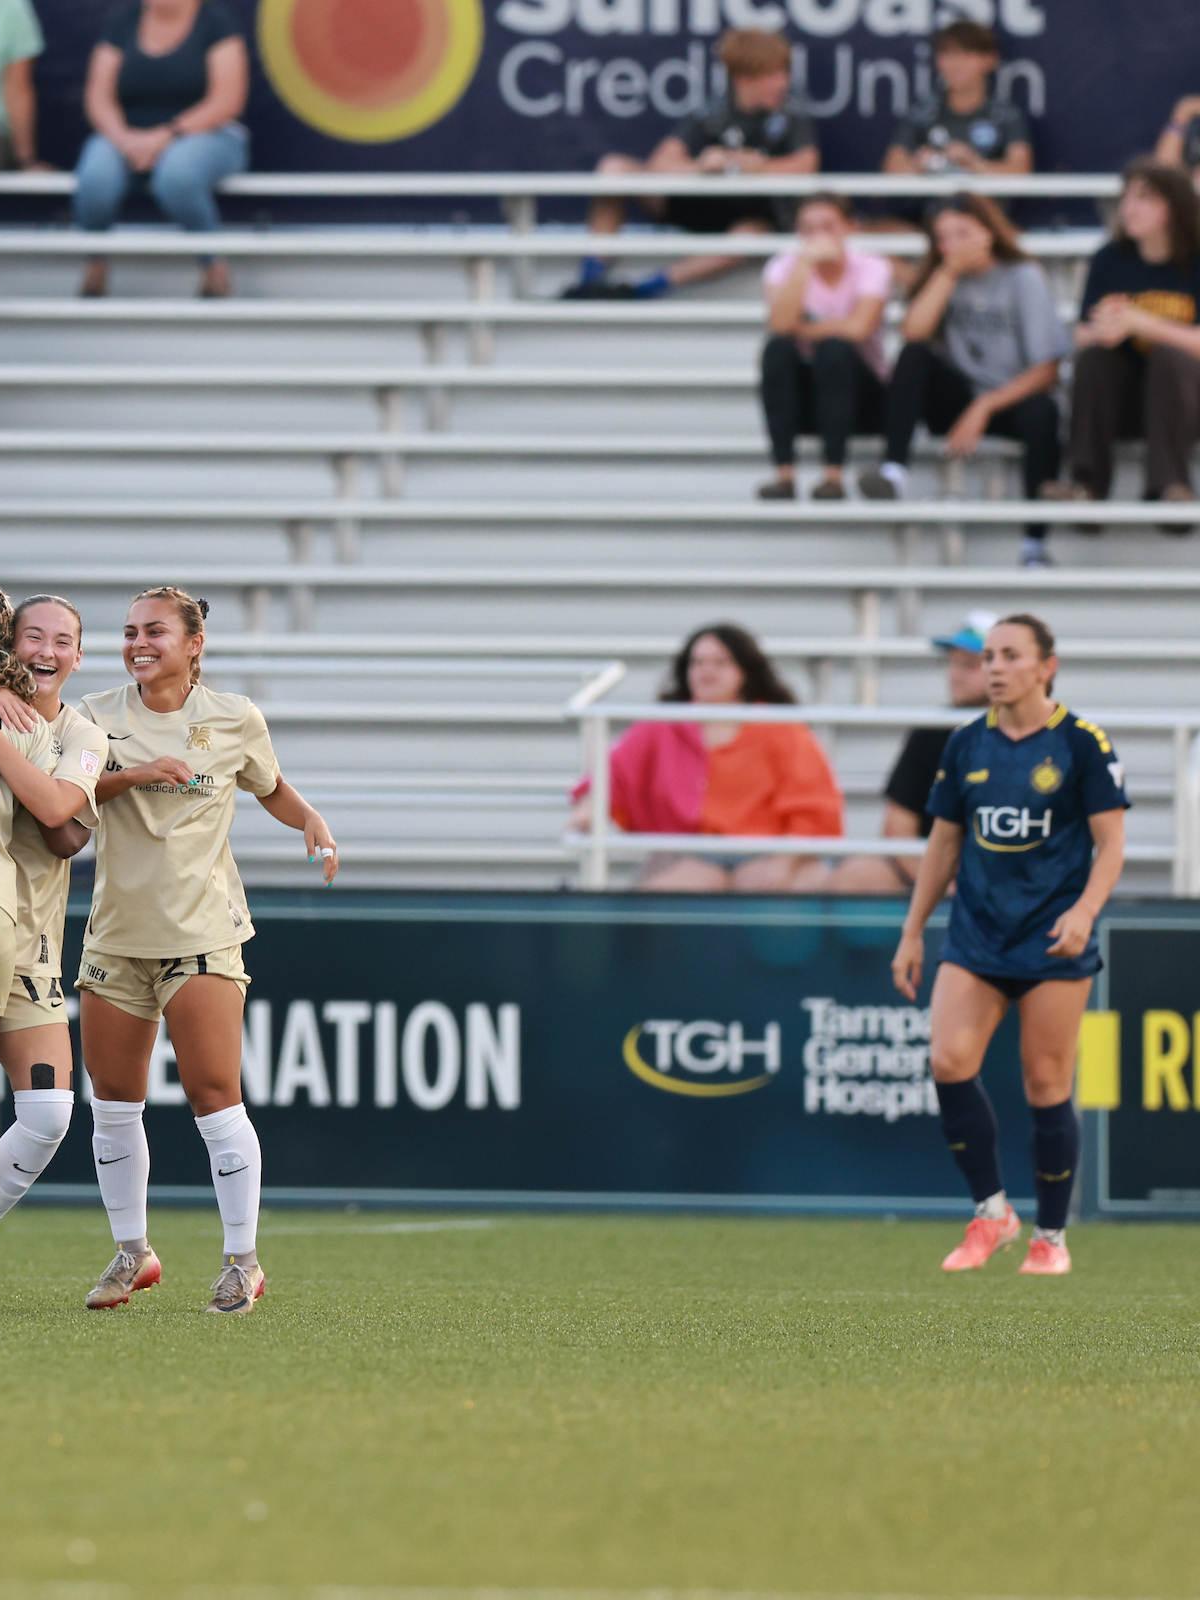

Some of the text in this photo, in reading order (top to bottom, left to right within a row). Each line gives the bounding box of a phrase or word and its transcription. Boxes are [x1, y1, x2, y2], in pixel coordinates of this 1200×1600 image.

[499, 40, 1046, 118] Credi Unin
[180, 785, 214, 797] Center
[976, 806, 1052, 838] TGH
[241, 1000, 521, 1111] NATION
[643, 1019, 781, 1074] TGH
[803, 1036, 931, 1078] Gener
[1143, 1009, 1200, 1112] R
[804, 1074, 940, 1122] Hospit
